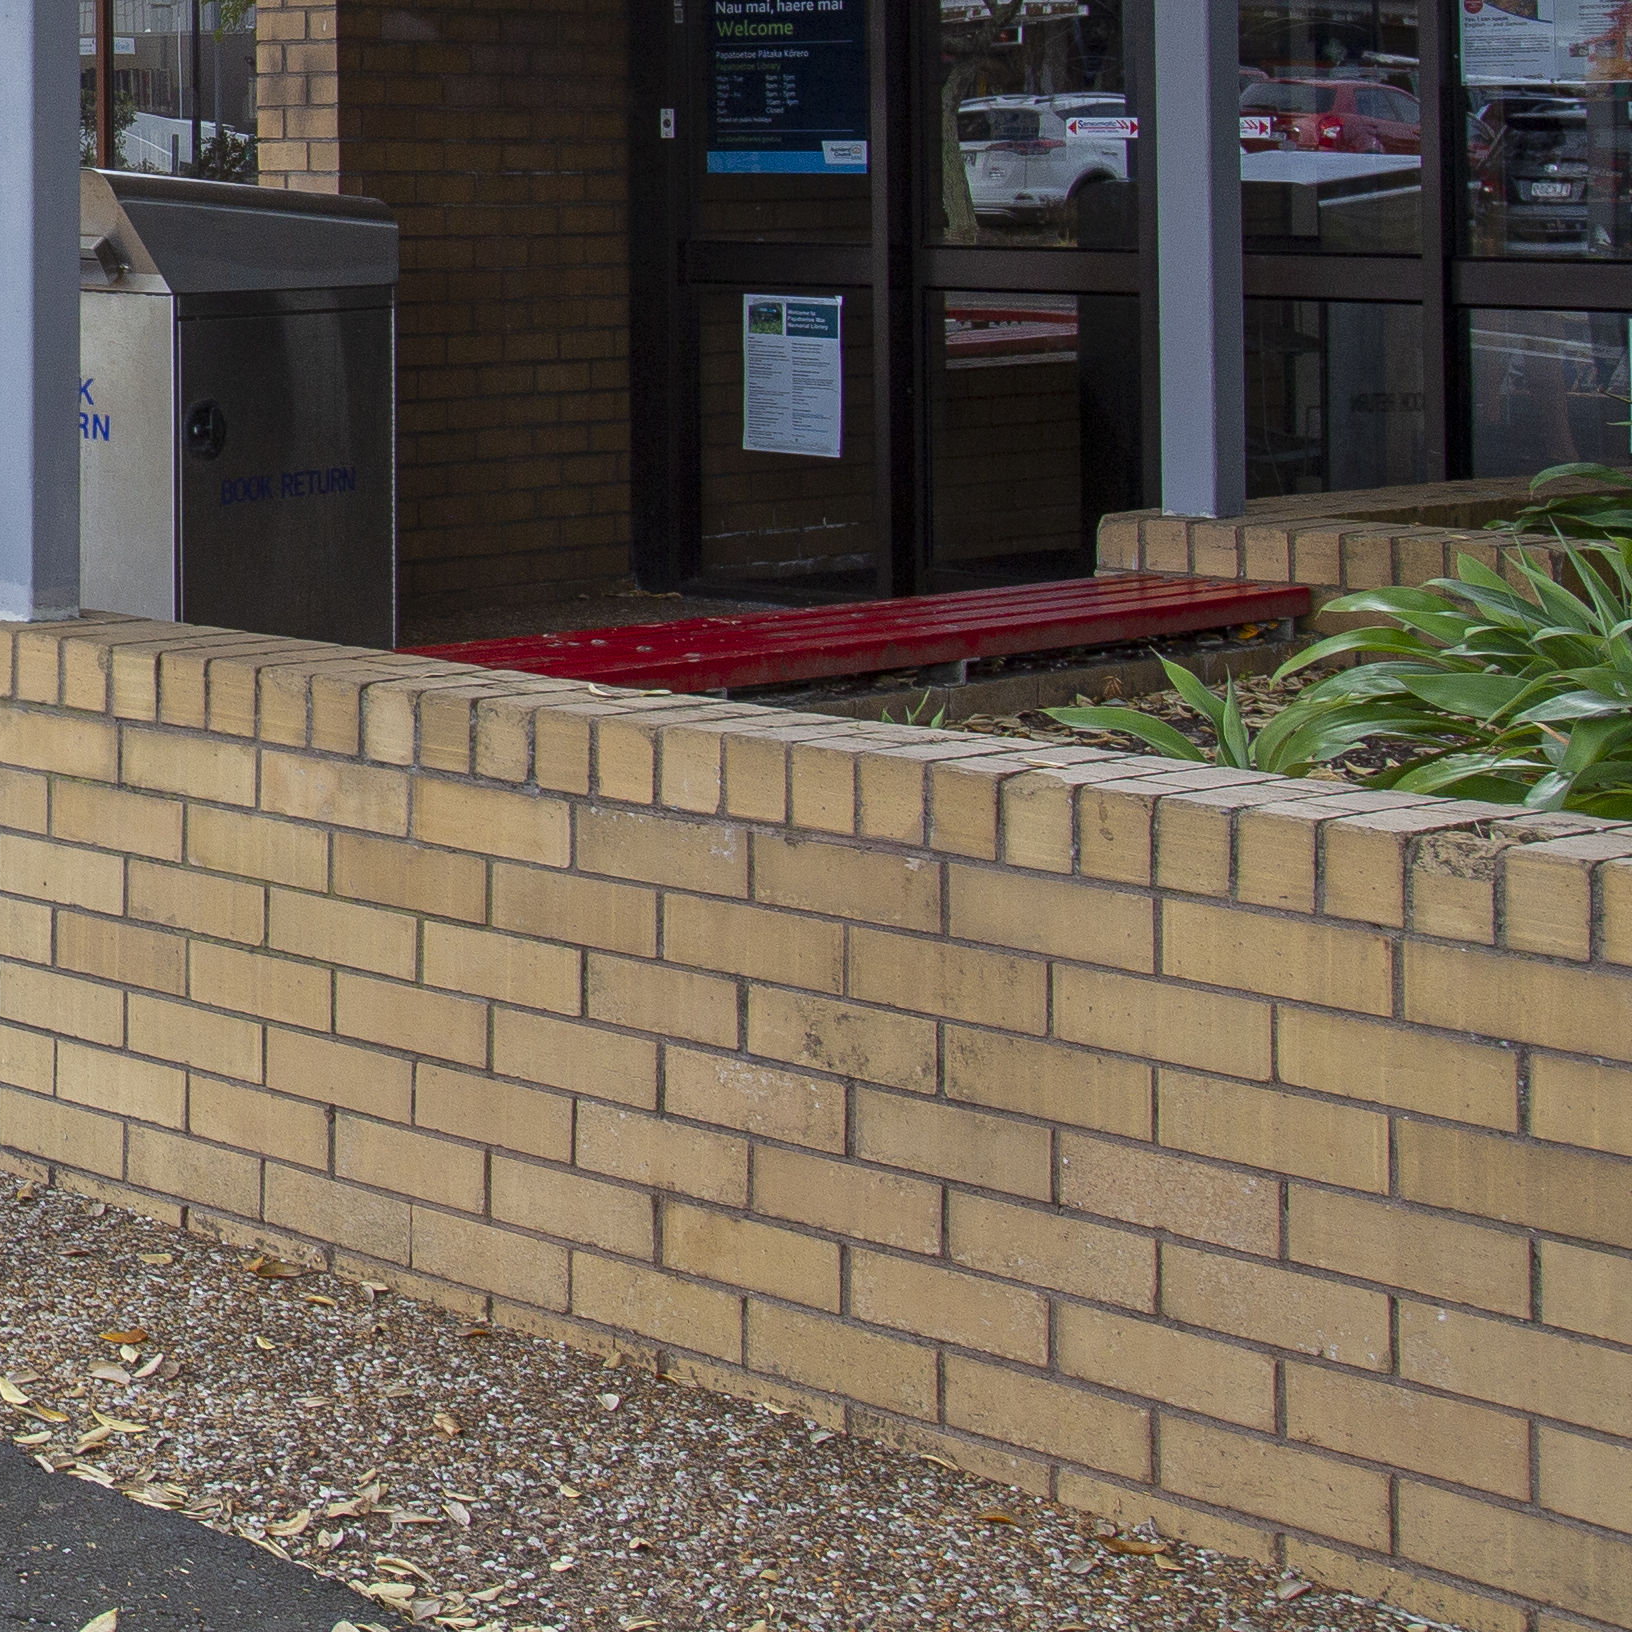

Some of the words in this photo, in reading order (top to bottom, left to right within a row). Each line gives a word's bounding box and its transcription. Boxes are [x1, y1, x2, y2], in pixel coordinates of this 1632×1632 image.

[715, 1, 742, 14] Nau
[717, 19, 793, 36] Welcome
[715, 50, 756, 61] Papatoetoe
[221, 475, 274, 505] BOOK
[280, 467, 356, 499] RETURN
